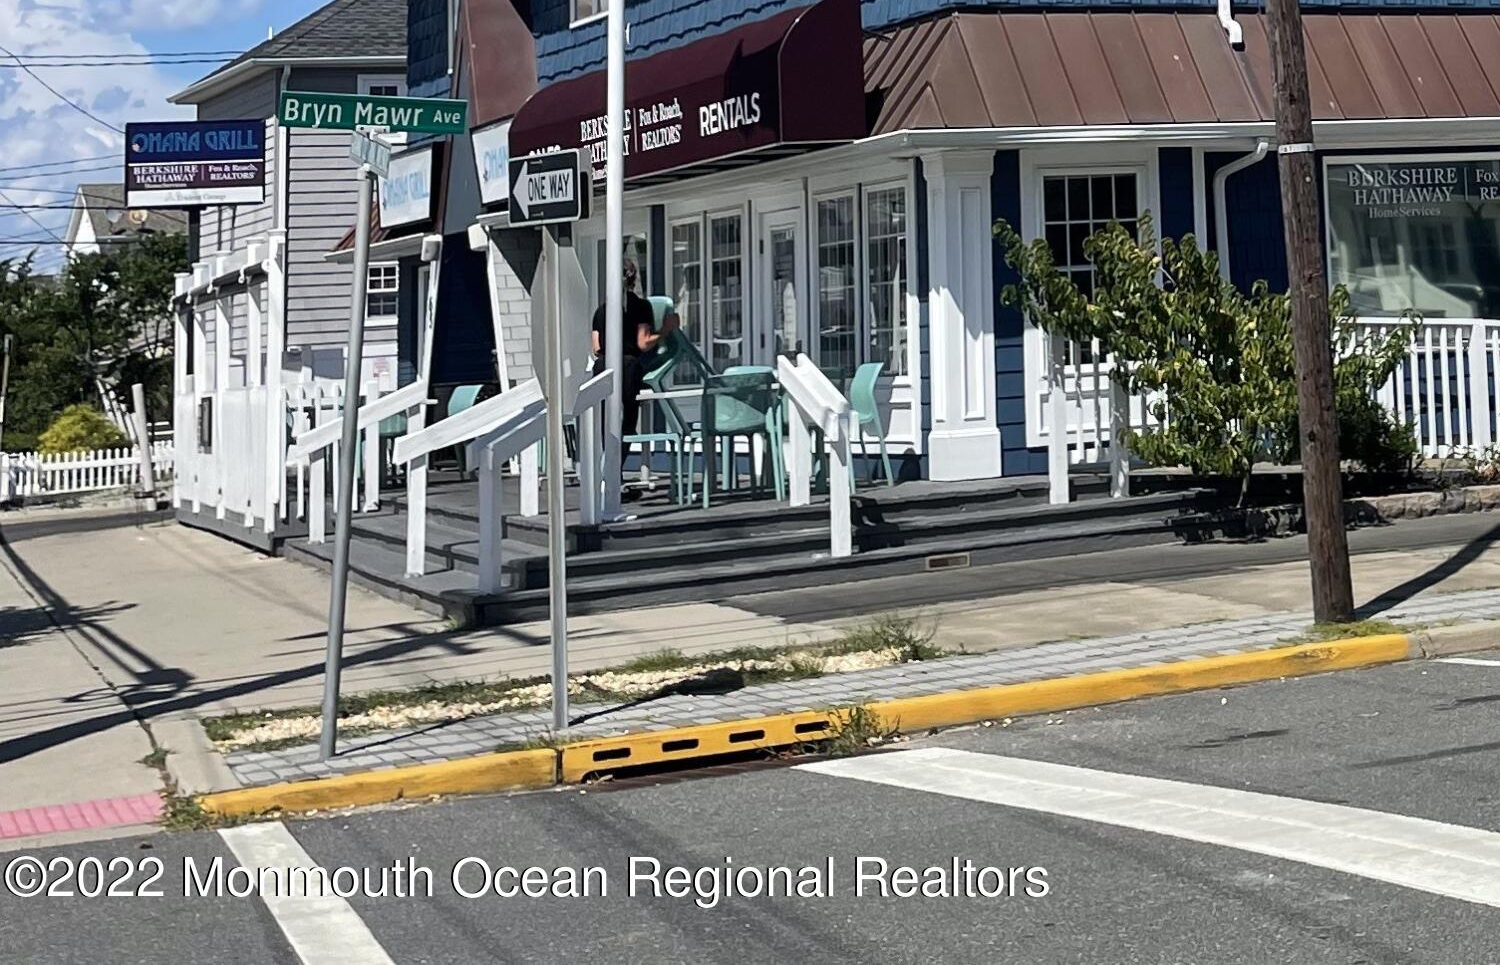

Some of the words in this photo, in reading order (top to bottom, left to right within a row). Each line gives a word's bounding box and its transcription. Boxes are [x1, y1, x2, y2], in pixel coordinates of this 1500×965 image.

[284, 98, 342, 128] Bryn
[354, 102, 423, 126] Mawr
[433, 110, 461, 124] Ave
[652, 104, 659, 124] &
[699, 92, 761, 137] RENTALS
[580, 109, 632, 142] BERKSE
[132, 132, 200, 153] OHANA
[204, 130, 258, 150] GRILL
[133, 165, 198, 175] BERKSHIRE
[224, 164, 231, 172] &
[136, 174, 195, 183] HATHAWAY
[210, 172, 255, 181] REALTORS
[1348, 167, 1458, 187] BERKSHIRE
[1476, 169, 1499, 182] Fox
[528, 175, 547, 202] ONE
[550, 172, 570, 199] WAY
[1354, 186, 1454, 205] HATHAWAY
[1369, 206, 1441, 219] HomeServices
